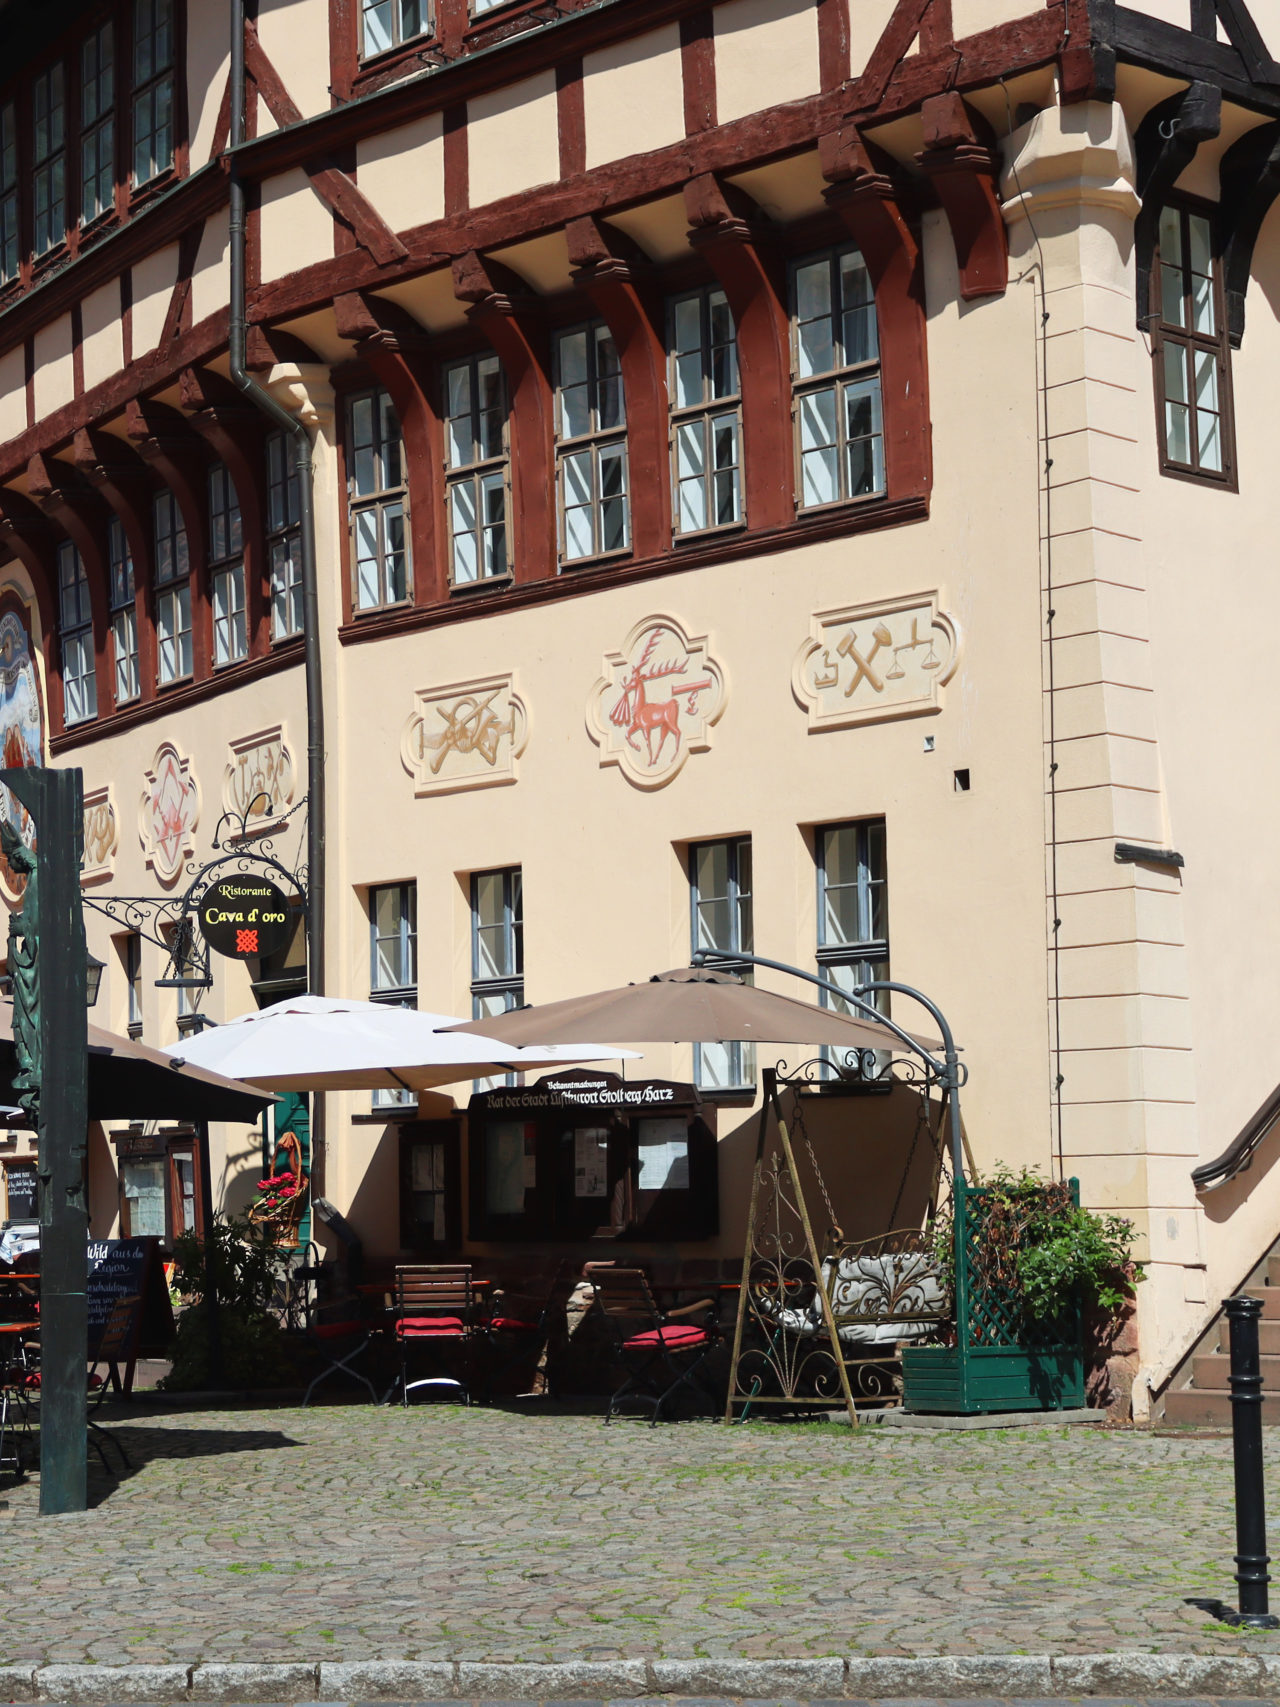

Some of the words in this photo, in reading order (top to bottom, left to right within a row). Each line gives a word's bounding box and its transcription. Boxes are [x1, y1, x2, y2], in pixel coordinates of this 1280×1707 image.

[218, 885, 272, 900] Ristorante
[205, 907, 244, 925] Cava
[262, 912, 286, 923] oro
[87, 1243, 109, 1259] Wild
